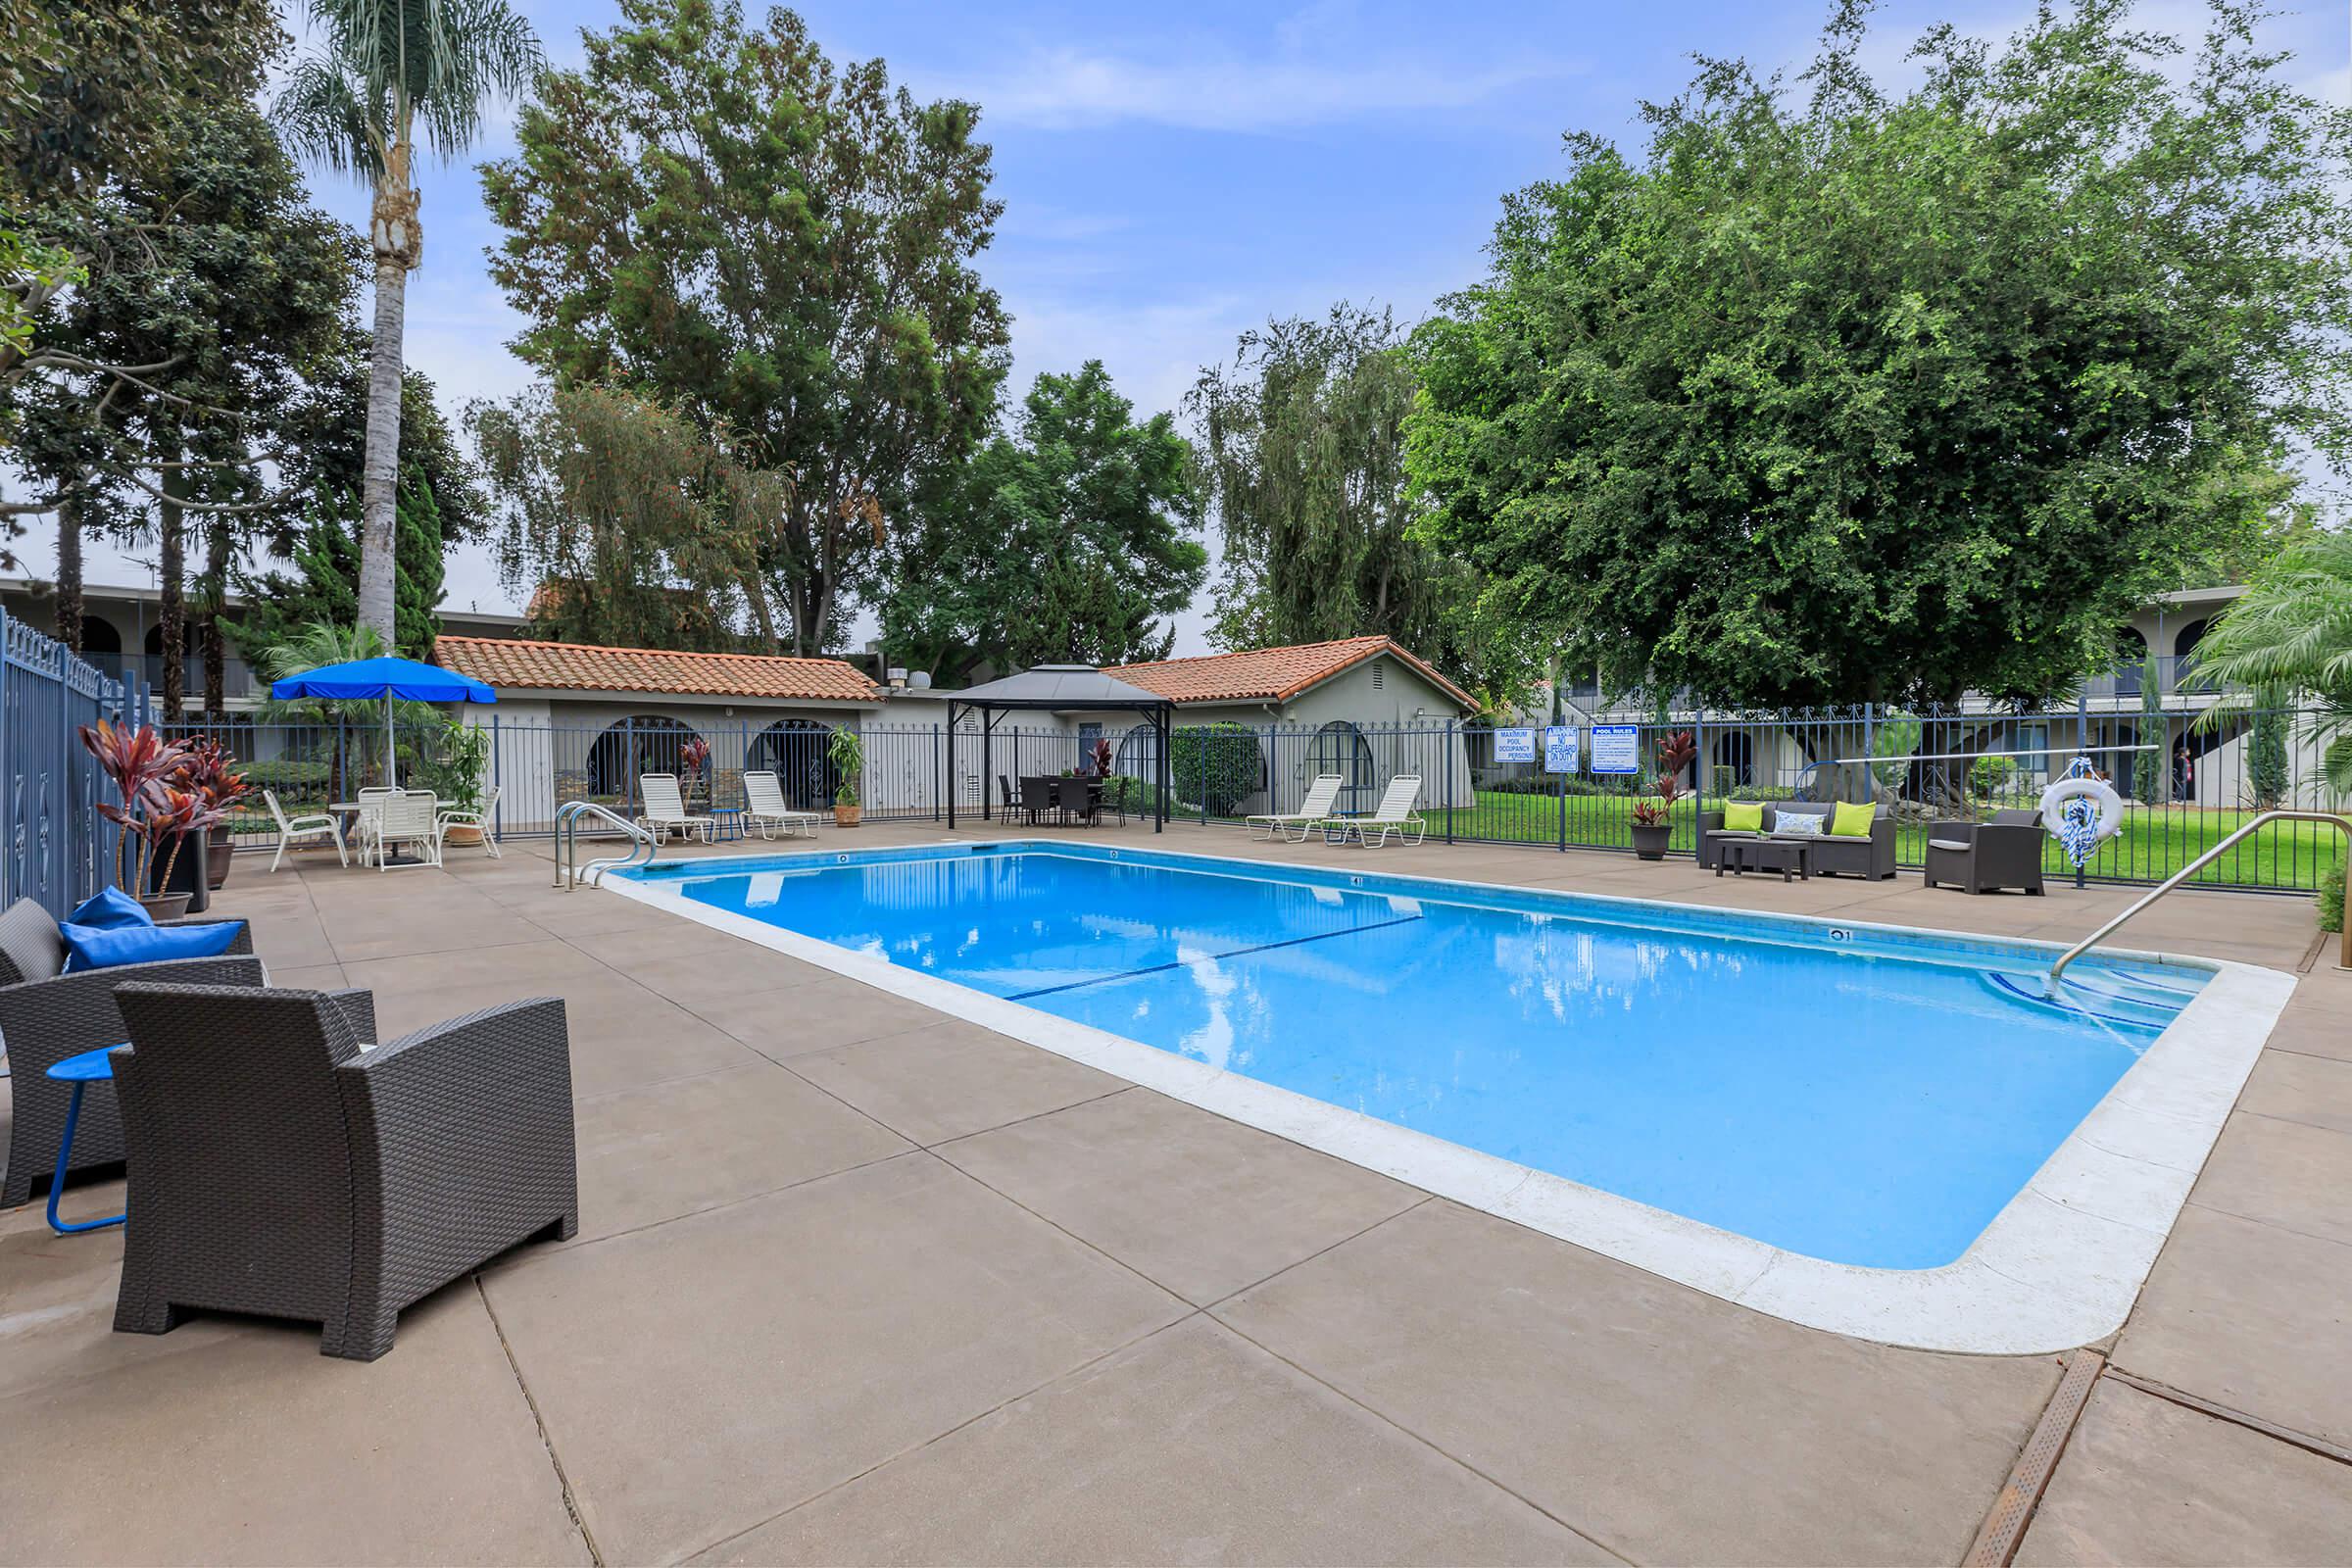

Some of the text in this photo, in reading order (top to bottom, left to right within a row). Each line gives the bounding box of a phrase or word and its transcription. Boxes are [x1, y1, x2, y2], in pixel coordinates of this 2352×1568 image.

[1558, 736, 1566, 745] NO
[1547, 745, 1576, 754] LIFEGUARD
[1550, 752, 1573, 761] ON DUTY
